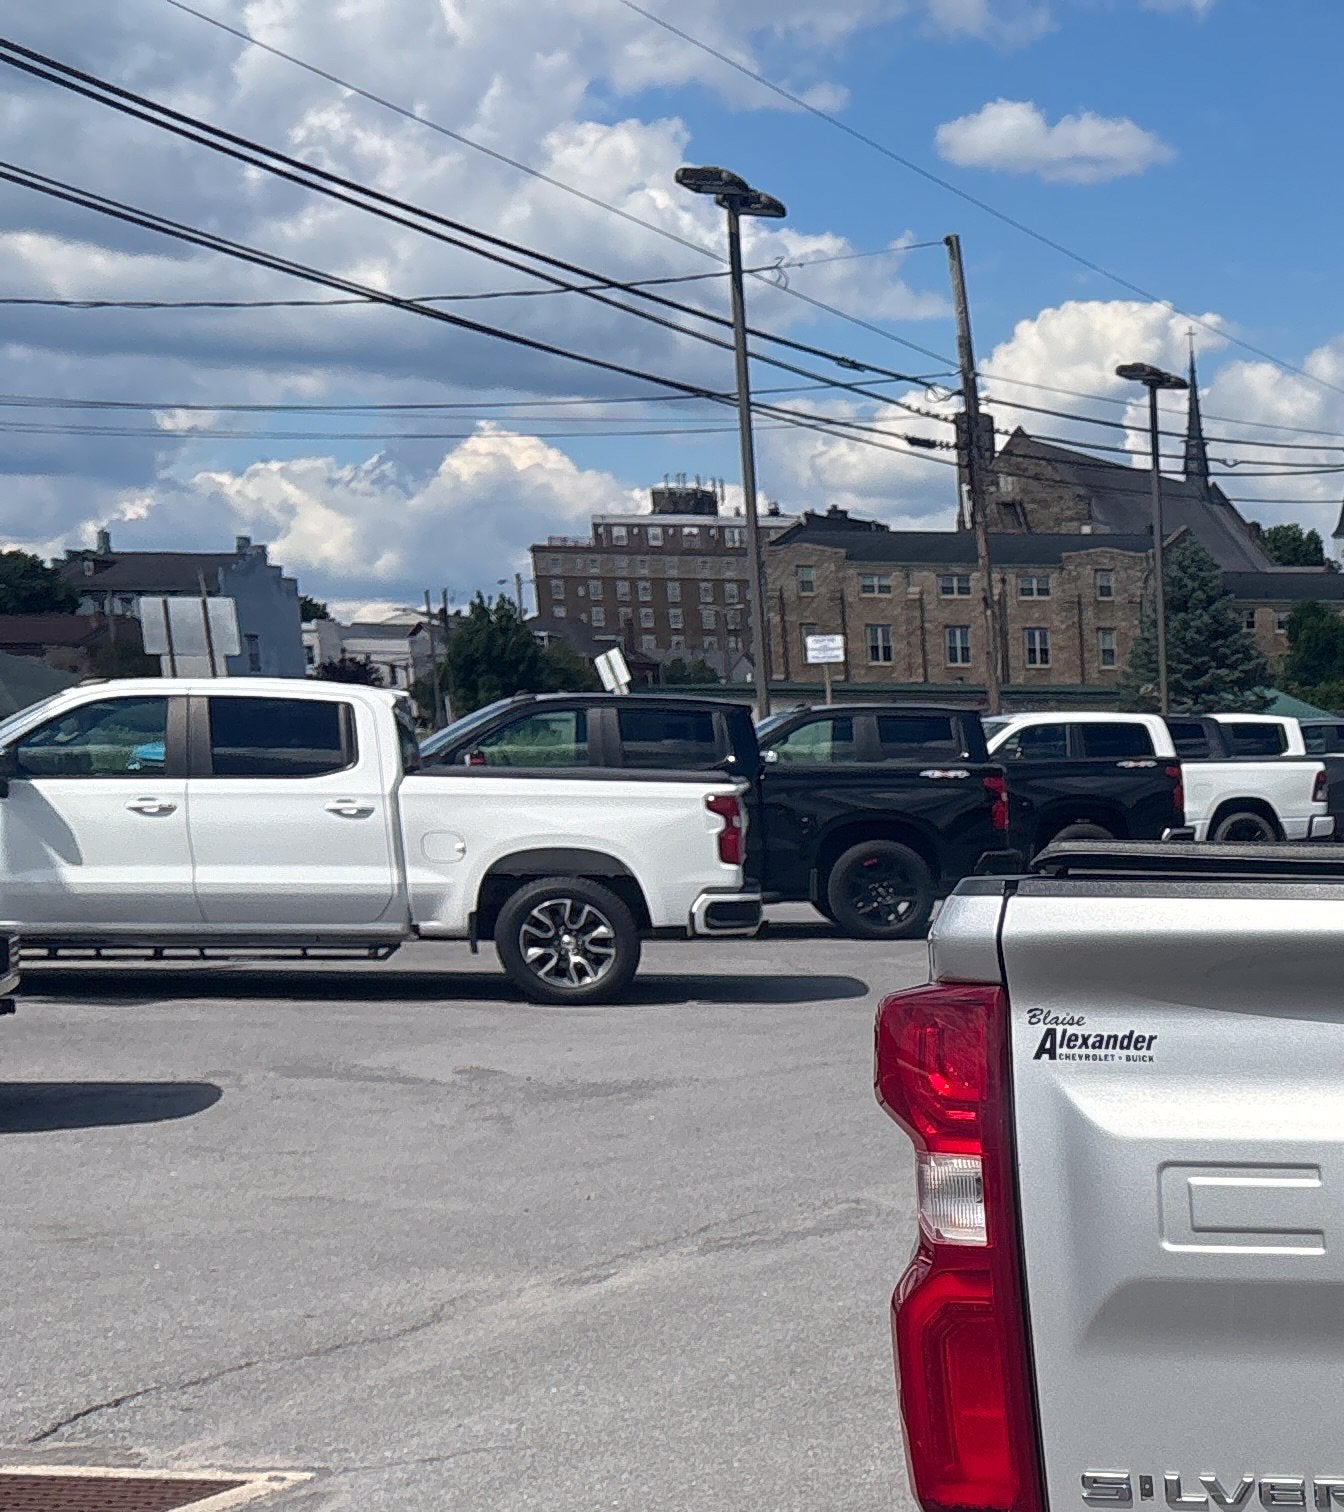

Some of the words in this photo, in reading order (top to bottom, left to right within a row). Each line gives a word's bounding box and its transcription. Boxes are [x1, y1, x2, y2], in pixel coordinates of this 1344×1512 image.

[1027, 1007, 1086, 1026] Blaise
[1033, 1027, 1158, 1060] Alexander
[1058, 1052, 1116, 1062] CHEVROLET
[1125, 1053, 1155, 1062] BUICK
